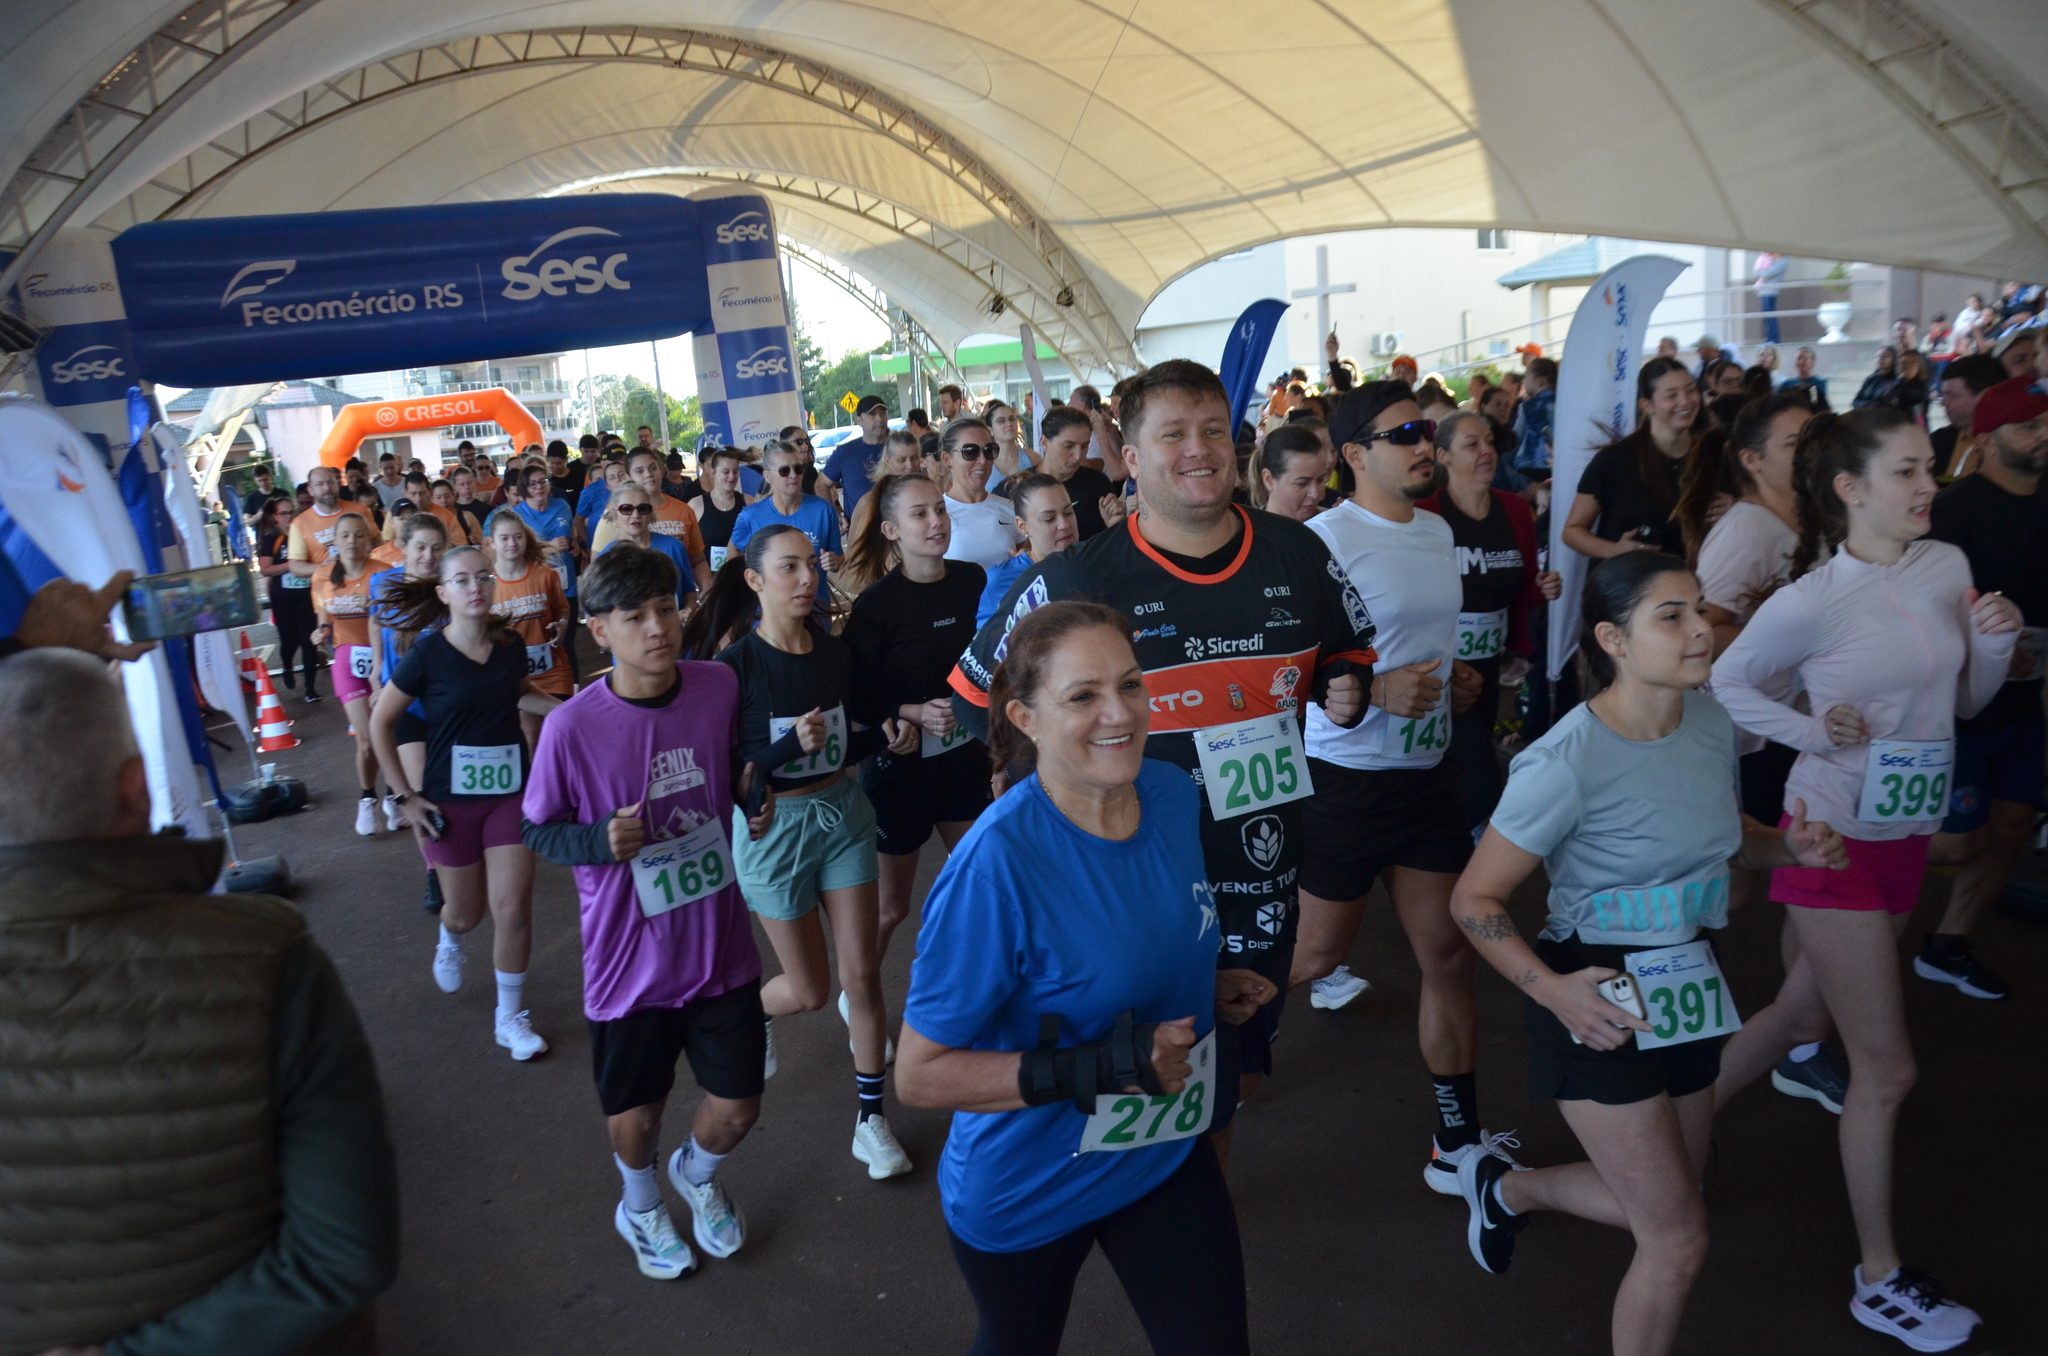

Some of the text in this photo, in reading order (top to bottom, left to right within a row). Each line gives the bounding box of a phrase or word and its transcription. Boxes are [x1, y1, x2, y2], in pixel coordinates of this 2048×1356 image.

[716, 223, 769, 244] Sesc
[501, 251, 631, 301] Sesc
[30, 281, 115, 297] Fecomércio RS
[242, 283, 464, 327] Fecomércio RS
[722, 295, 772, 308] Fecomércio
[52, 357, 126, 384] Sesc
[736, 356, 788, 379] Sesc
[404, 400, 481, 421] CRESOL
[714, 556, 728, 571] 2
[1274, 586, 1291, 597] URI
[1145, 601, 1165, 613] URI
[933, 616, 956, 629] PANDA
[1207, 633, 1264, 655] Sicredi
[1458, 627, 1502, 657] 343
[1208, 737, 1236, 752] Sesc
[1400, 712, 1449, 754] 143
[1879, 753, 1917, 768] Sesc
[461, 763, 513, 790] 380
[1219, 745, 1298, 810] 205
[1875, 771, 1947, 817] 399
[642, 852, 676, 869] Sesc
[653, 849, 724, 905] 169
[1208, 866, 1298, 895] VENCE TUD
[1637, 964, 1670, 978] Sesc
[1649, 976, 1724, 1040] 397
[1101, 1080, 1206, 1144] 278
[1433, 1082, 1466, 1129] RUN
